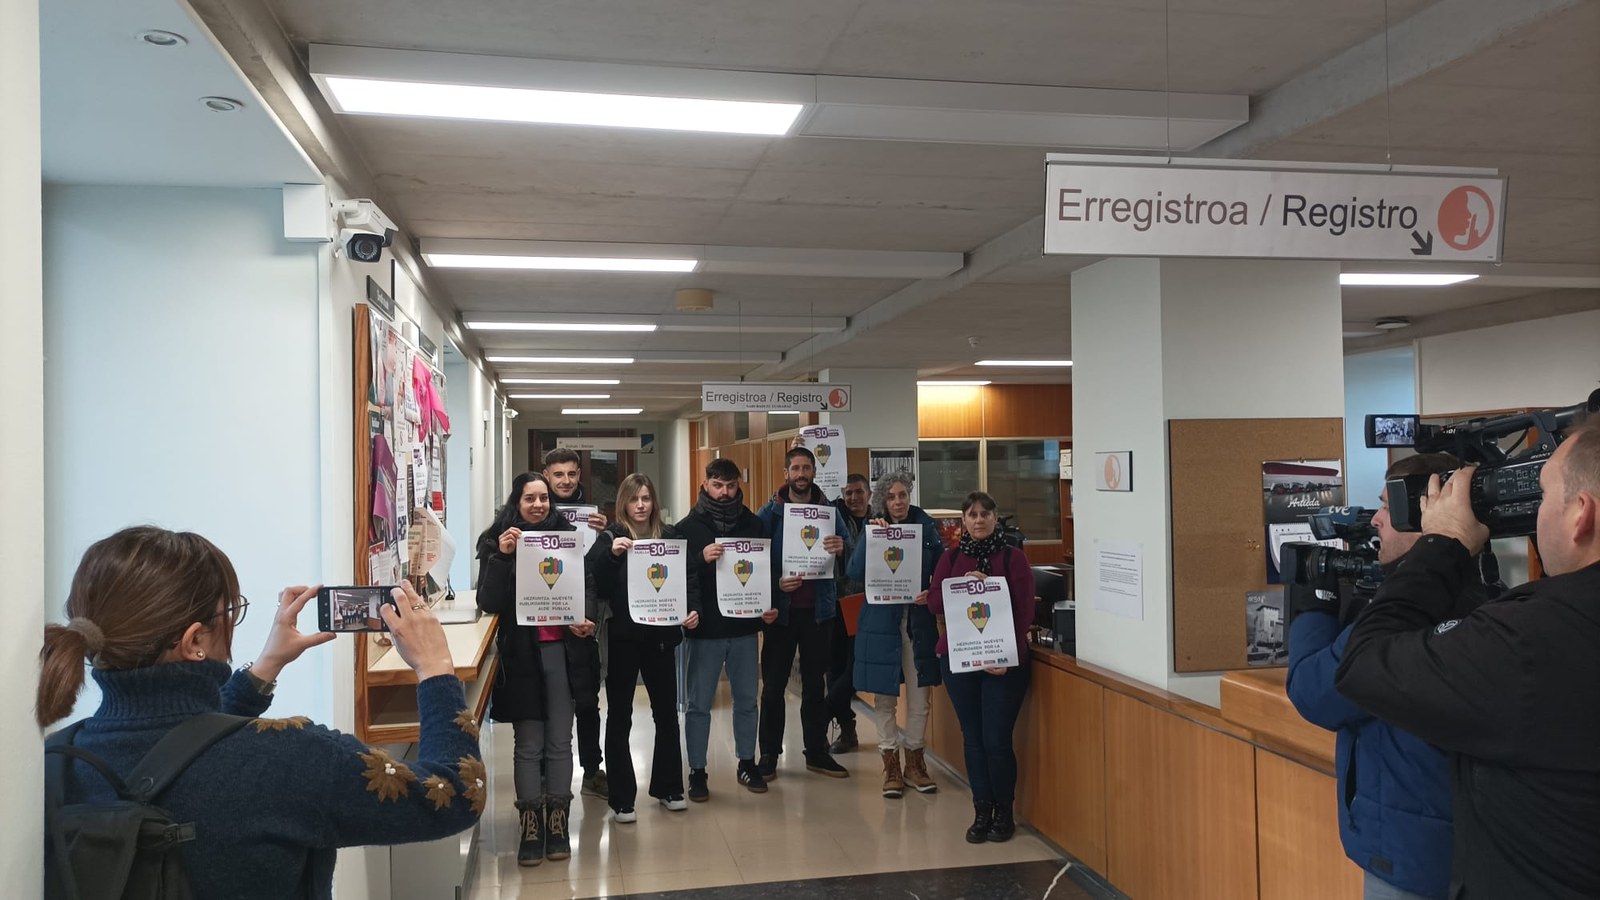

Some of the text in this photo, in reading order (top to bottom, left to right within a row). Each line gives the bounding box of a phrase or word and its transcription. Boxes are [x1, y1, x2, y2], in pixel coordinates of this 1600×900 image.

[1058, 188, 1418, 236] Erregistroa / Registro
[706, 392, 822, 404] Erregistroa / Registro
[815, 429, 827, 438] 30
[804, 509, 817, 518] 30
[888, 529, 900, 538] 30
[542, 537, 558, 548] 30
[736, 542, 750, 551] 30
[650, 544, 665, 555] 30
[968, 581, 984, 593] 30
